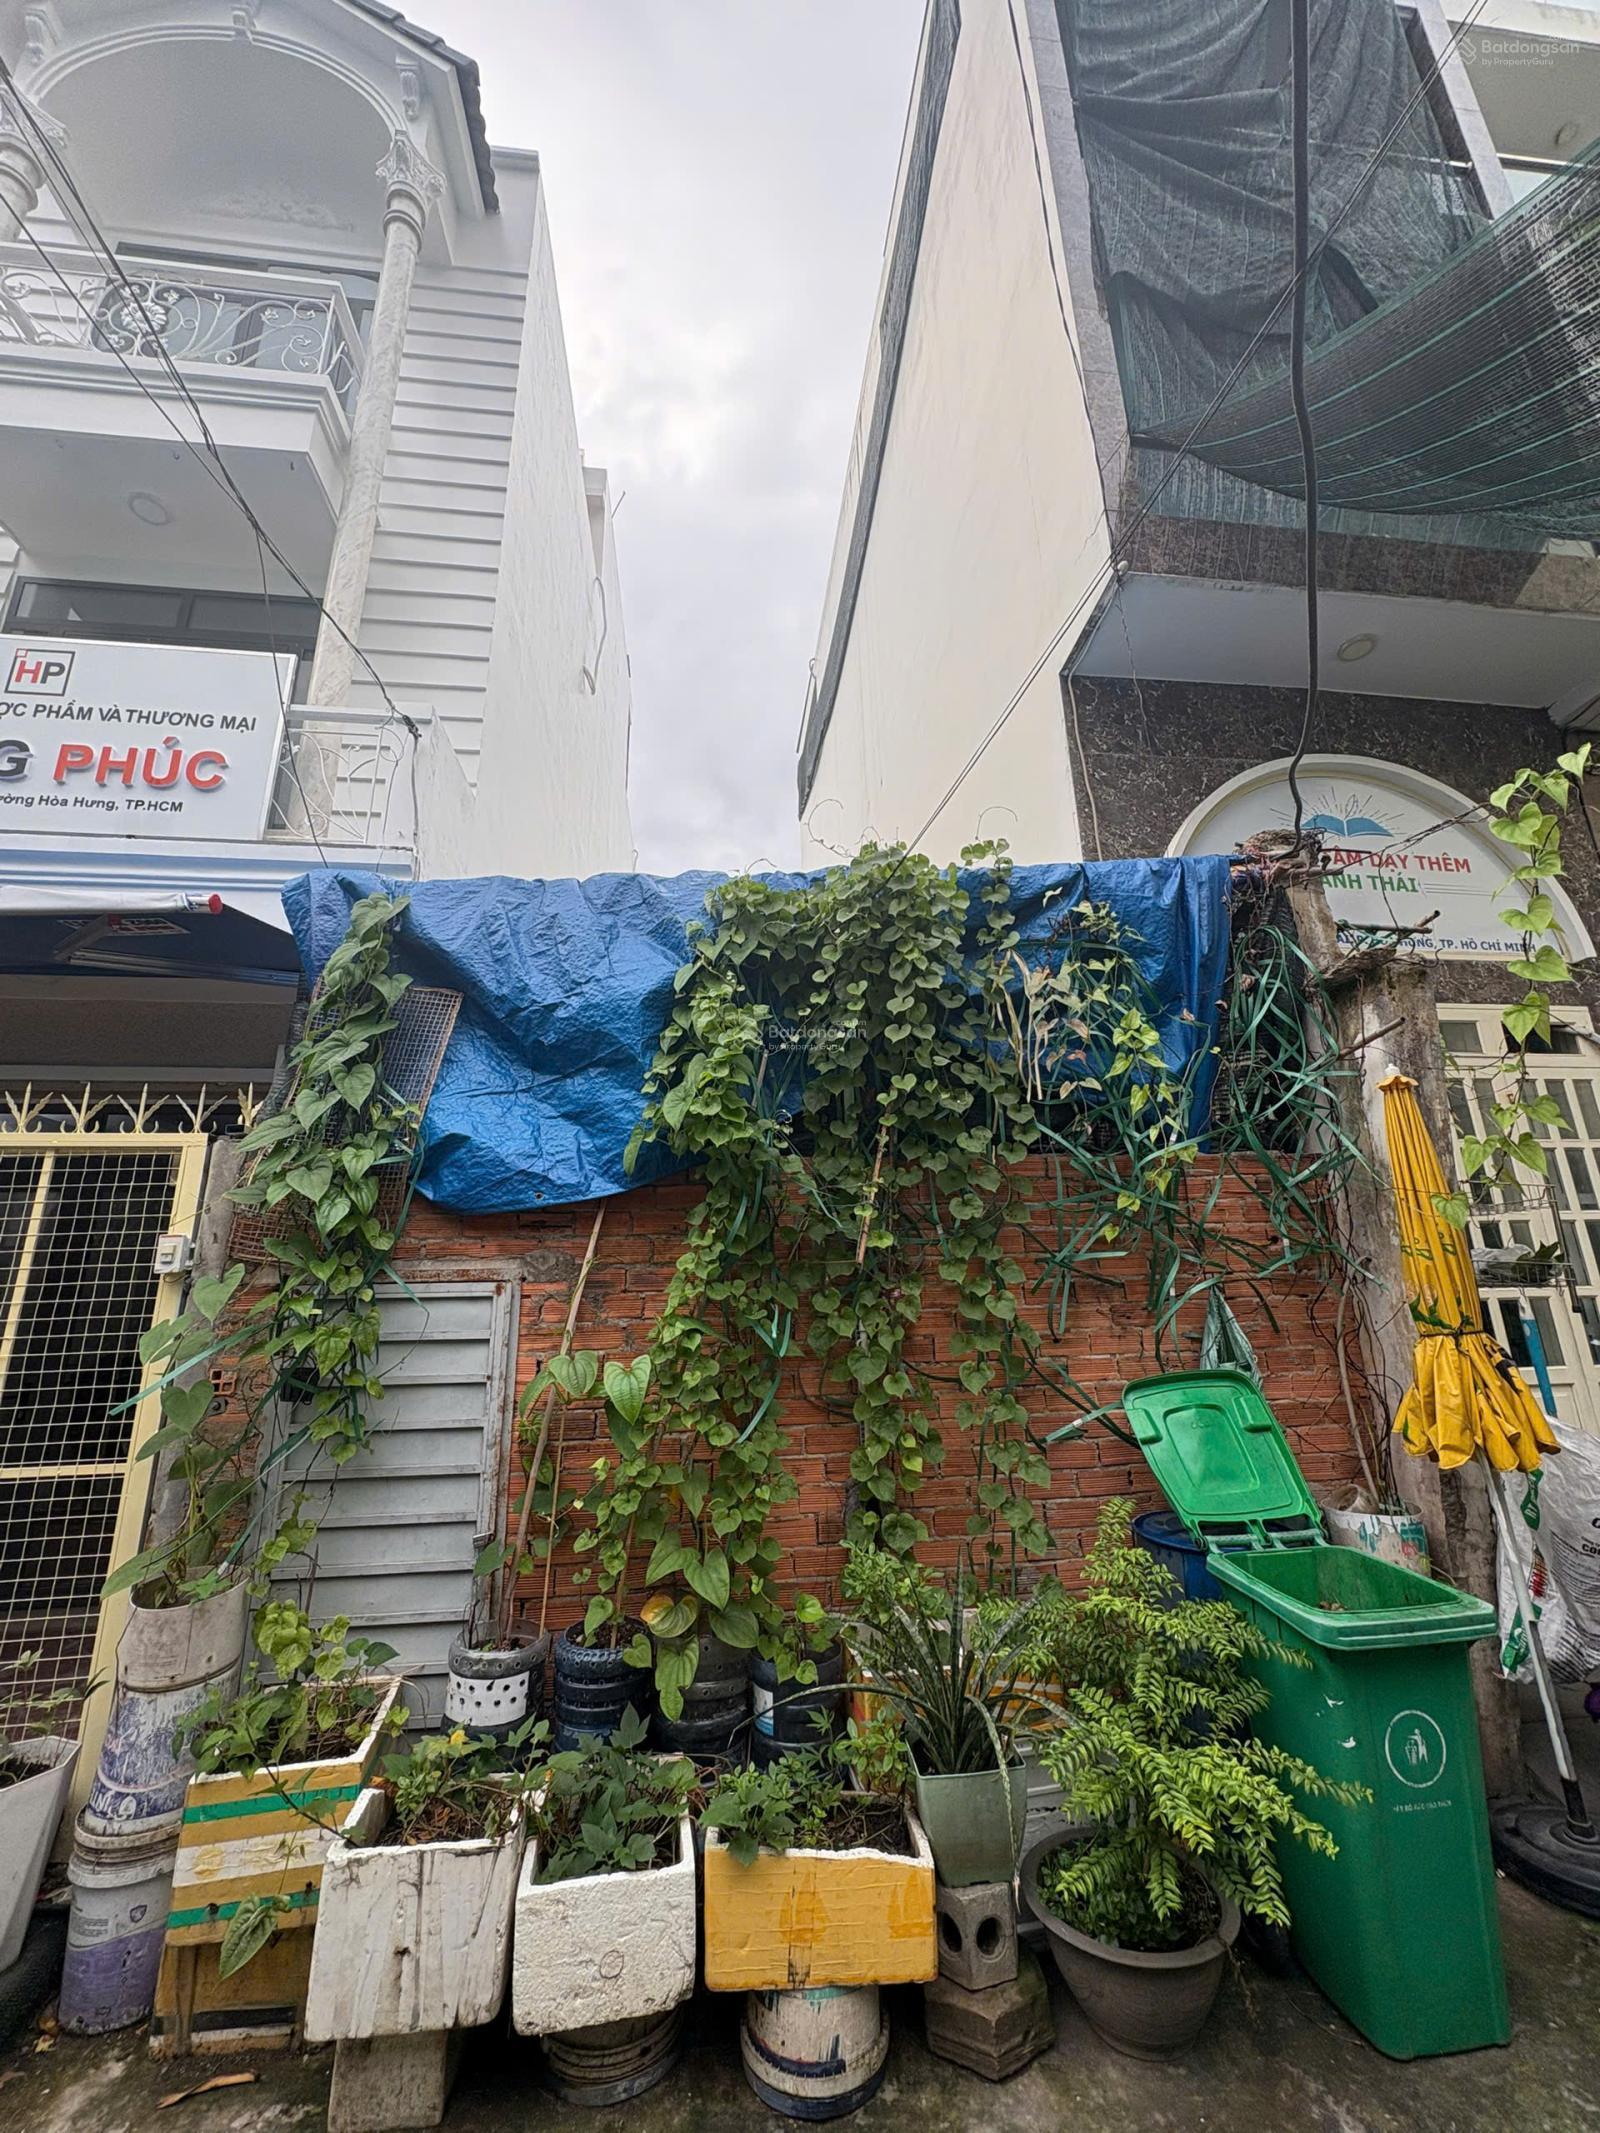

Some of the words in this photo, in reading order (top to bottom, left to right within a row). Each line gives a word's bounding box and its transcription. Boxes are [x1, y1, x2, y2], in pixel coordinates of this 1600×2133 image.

[14, 659, 65, 685] HP
[32, 699, 94, 721] PHẨM
[98, 705, 123, 723] VÀ
[125, 709, 214, 729] THƯƠNG
[220, 715, 257, 733] MẠI
[53, 736, 229, 791] PHÚC
[38, 794, 69, 807] Hòa
[72, 796, 119, 811] Hưng,
[125, 799, 184, 813] TP.HCM
[1369, 853, 1409, 873] DẠY
[1414, 851, 1472, 874] THÊM
[1366, 872, 1419, 893] THÁI
[1439, 938, 1458, 949] TP.
[1461, 935, 1480, 950] HỒ
[1480, 937, 1502, 951] CHÍ
